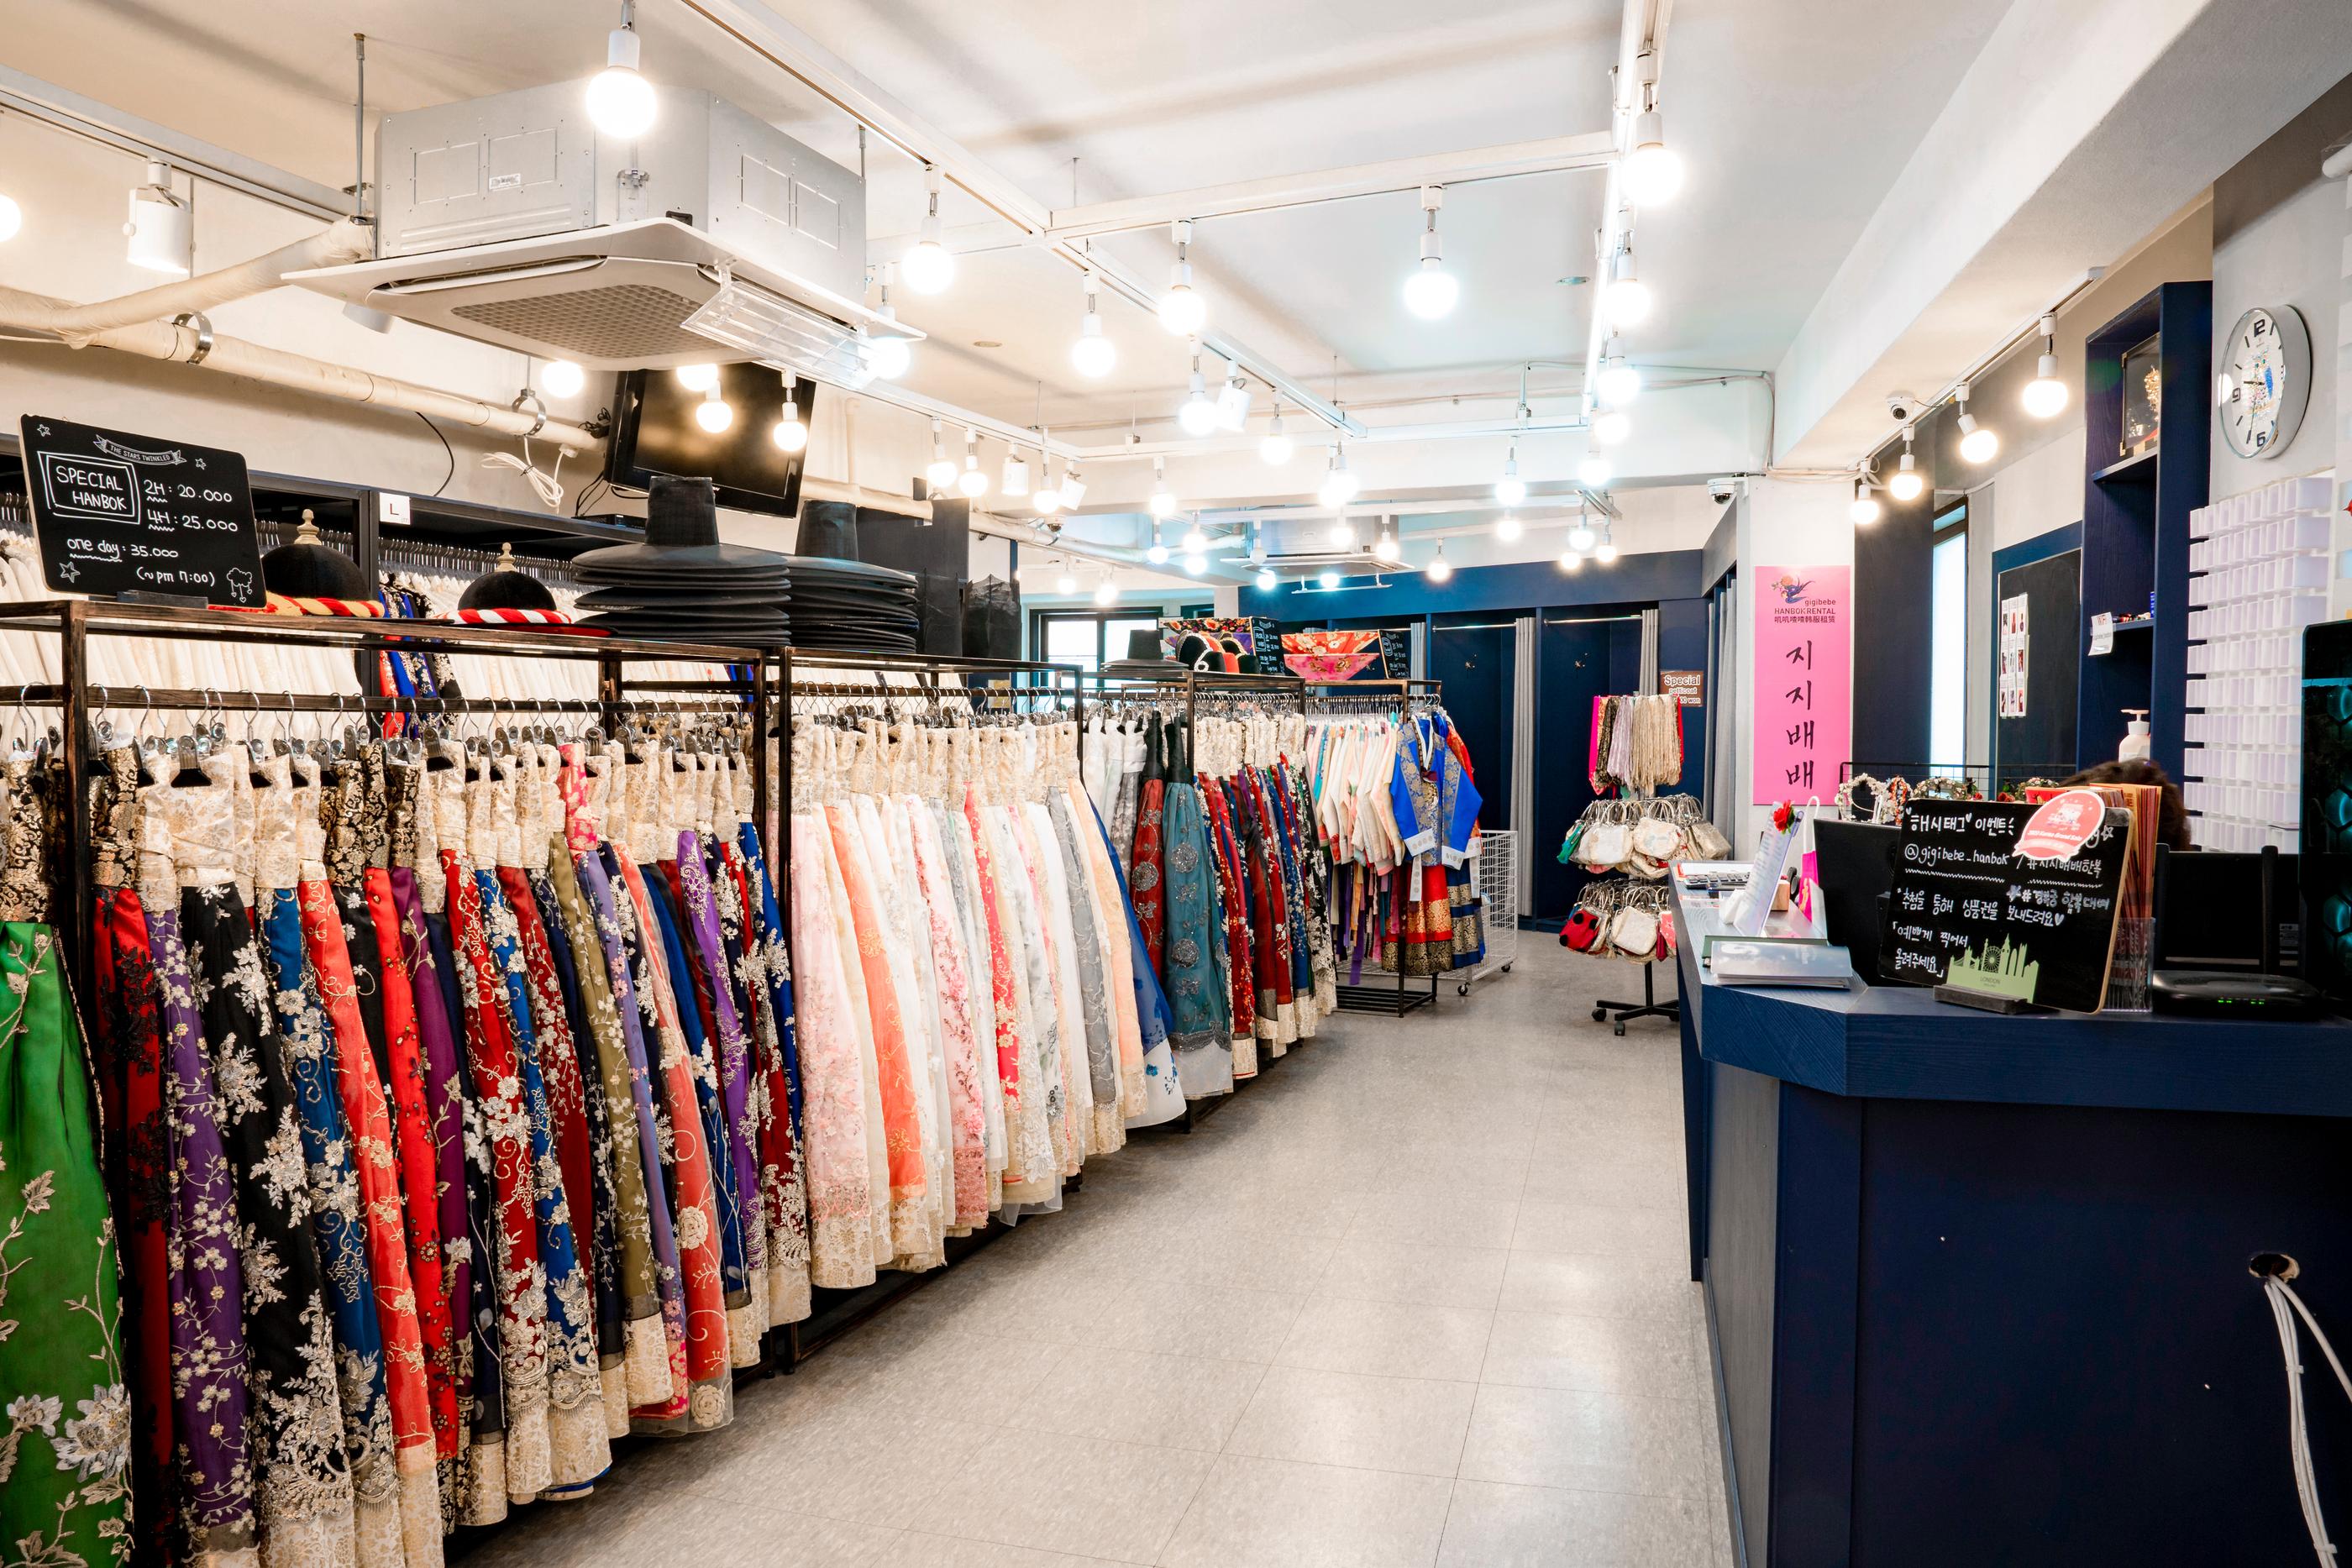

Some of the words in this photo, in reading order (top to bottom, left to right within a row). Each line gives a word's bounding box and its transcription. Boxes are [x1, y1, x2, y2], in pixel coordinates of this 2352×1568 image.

[2232, 387, 2241, 403] 9
[2256, 432, 2266, 447] 6
[110, 445, 122, 454] THE
[123, 450, 141, 460] STARS
[55, 465, 123, 490] SPECIAL
[72, 490, 127, 511] HANBOK
[177, 484, 233, 502] 20.000
[390, 503, 399, 516] L
[182, 515, 238, 532] 25.000
[67, 538, 93, 551] one
[130, 544, 178, 558] 35.000
[1664, 674, 1701, 687] Special
[1785, 640, 1814, 789] 지지배배
[1910, 815, 1966, 832] 해시태그
[1975, 816, 2007, 836] 이벤트
[1933, 894, 1954, 915] 통해
[1962, 899, 1998, 920] 상품권을
[2007, 905, 2054, 926] 보내드려요
[1940, 931, 1968, 948] 찍어서
